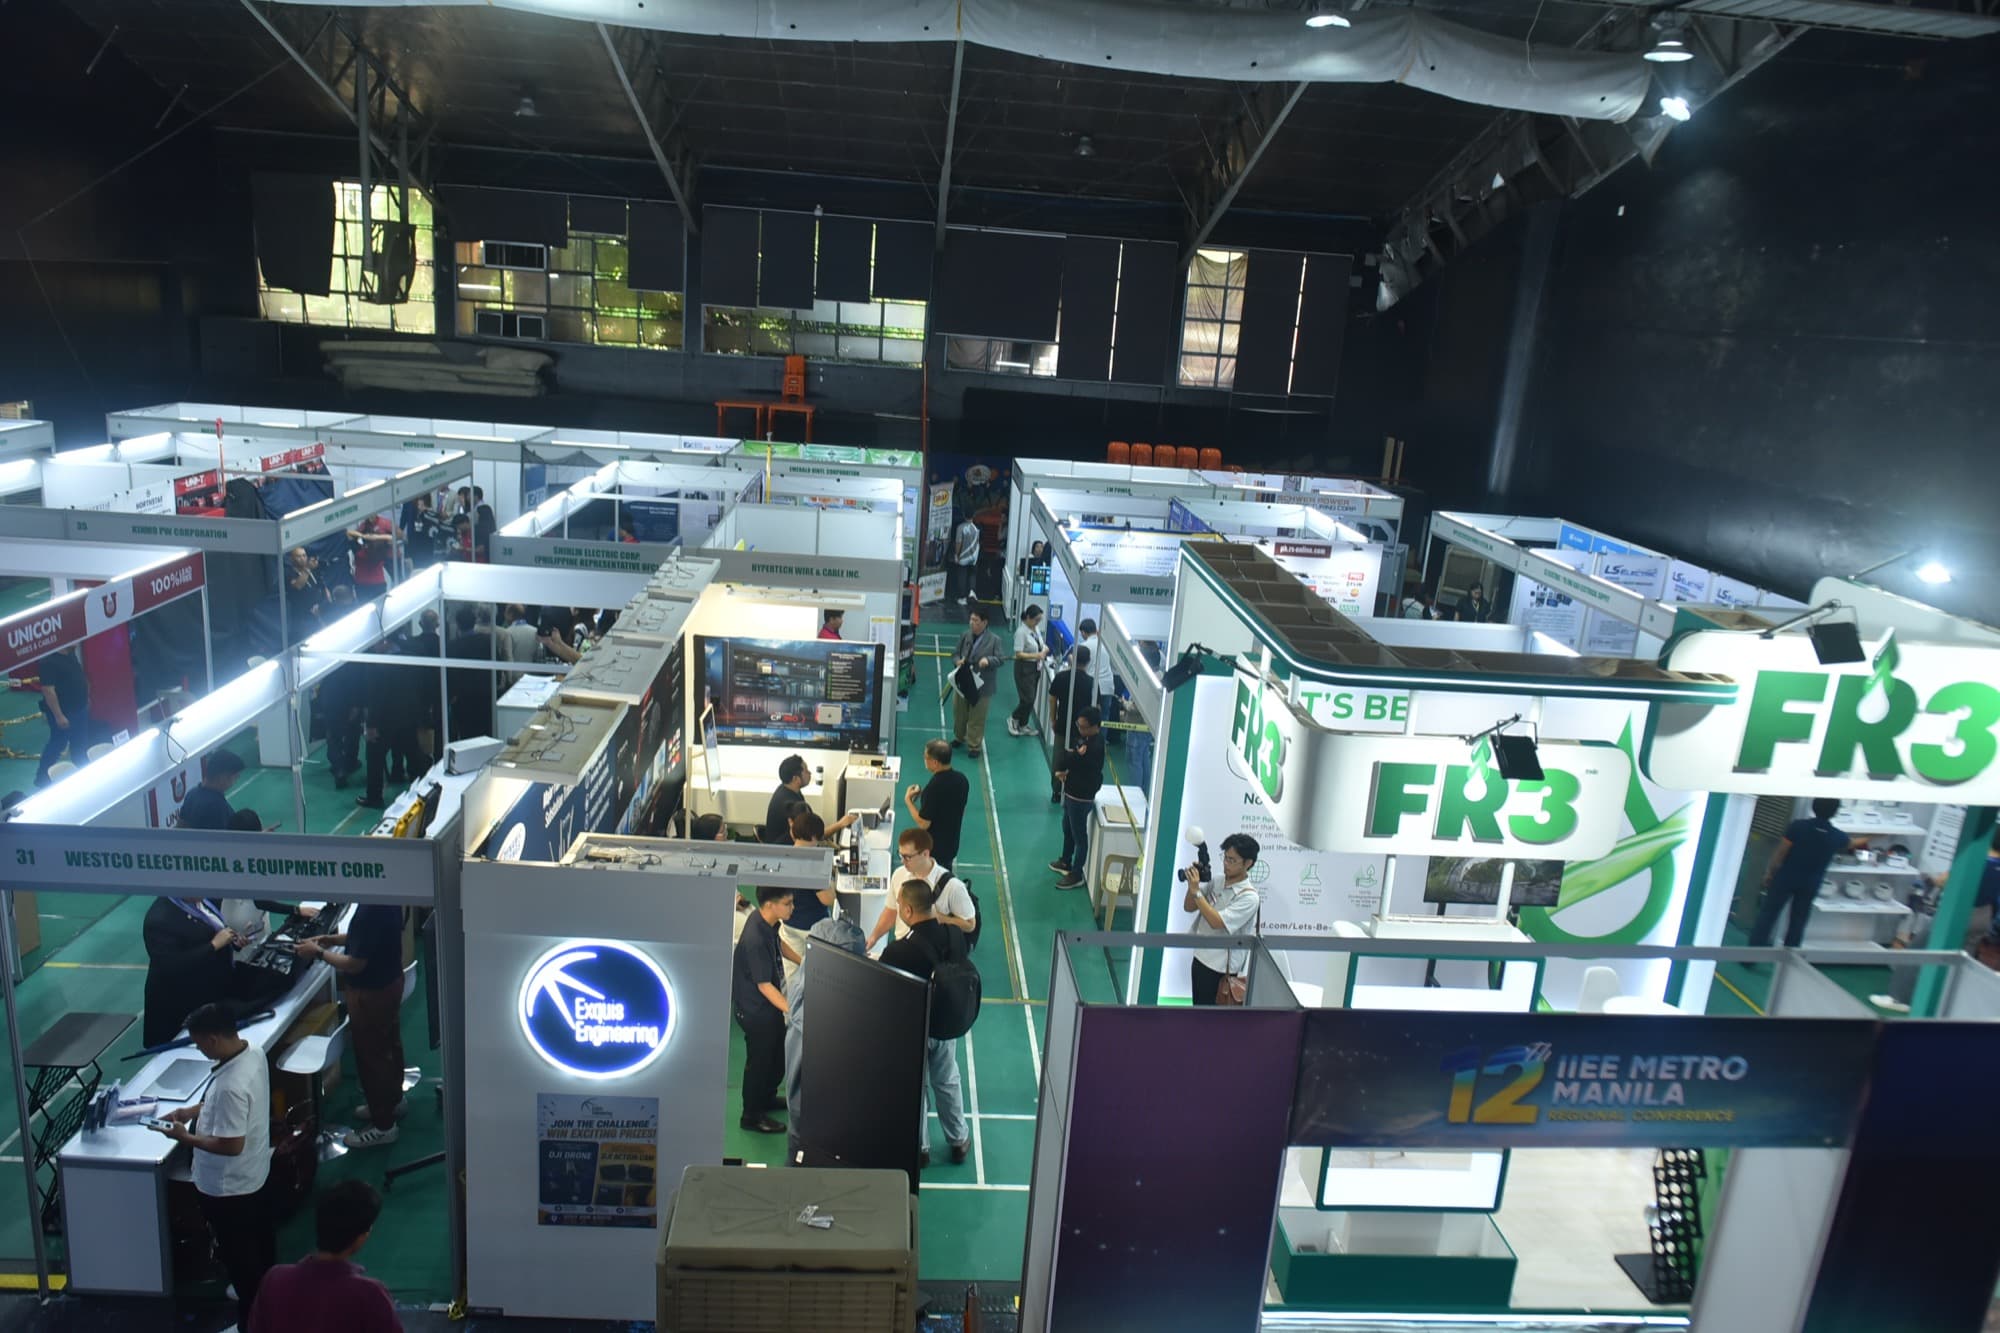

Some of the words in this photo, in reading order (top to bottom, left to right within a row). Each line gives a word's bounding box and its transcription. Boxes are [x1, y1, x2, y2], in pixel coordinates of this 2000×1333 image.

[173, 528, 228, 539] CORPORATION
[579, 558, 642, 571] REPRESENTATIVE
[584, 549, 618, 560] ELECTRIC
[751, 563, 794, 574] HYPERTECH
[794, 566, 813, 576] WIRE
[822, 568, 845, 578] CABLE
[846, 570, 860, 579] INC.
[1604, 564, 1621, 575] LS
[150, 571, 180, 596] 100%
[1130, 586, 1155, 596] WATTS
[1155, 588, 1169, 597] APP
[7, 613, 62, 648] UNICON
[15, 645, 33, 657] WIRES
[38, 634, 57, 648] CABLES
[1301, 691, 1354, 719] T'S
[1232, 678, 1285, 803] FR3
[1733, 670, 2000, 787] FR3
[1364, 760, 1582, 846] FR3
[16, 848, 36, 865] 31
[64, 849, 134, 869] WESTCO
[137, 853, 229, 873] ELECTRICAL
[233, 860, 245, 873] &
[247, 857, 340, 877] EQUIPMENT
[341, 860, 387, 880] CORP.
[574, 996, 625, 1025] Exquis
[574, 1020, 659, 1049] Engineering
[1557, 1054, 1620, 1080] IIEE
[1629, 1055, 1748, 1081] METRO
[1552, 1081, 1685, 1106] MANILA
[551, 1119, 574, 1129] JOIN
[577, 1119, 594, 1129] THE
[596, 1119, 650, 1129] CHALLENGE
[1547, 1110, 1625, 1121] REGIONAL
[1632, 1110, 1736, 1122] CONFERENCE
[546, 1127, 569, 1138] WIN
[570, 1128, 617, 1139] EXCITING
[563, 1151, 593, 1161] DRONE
